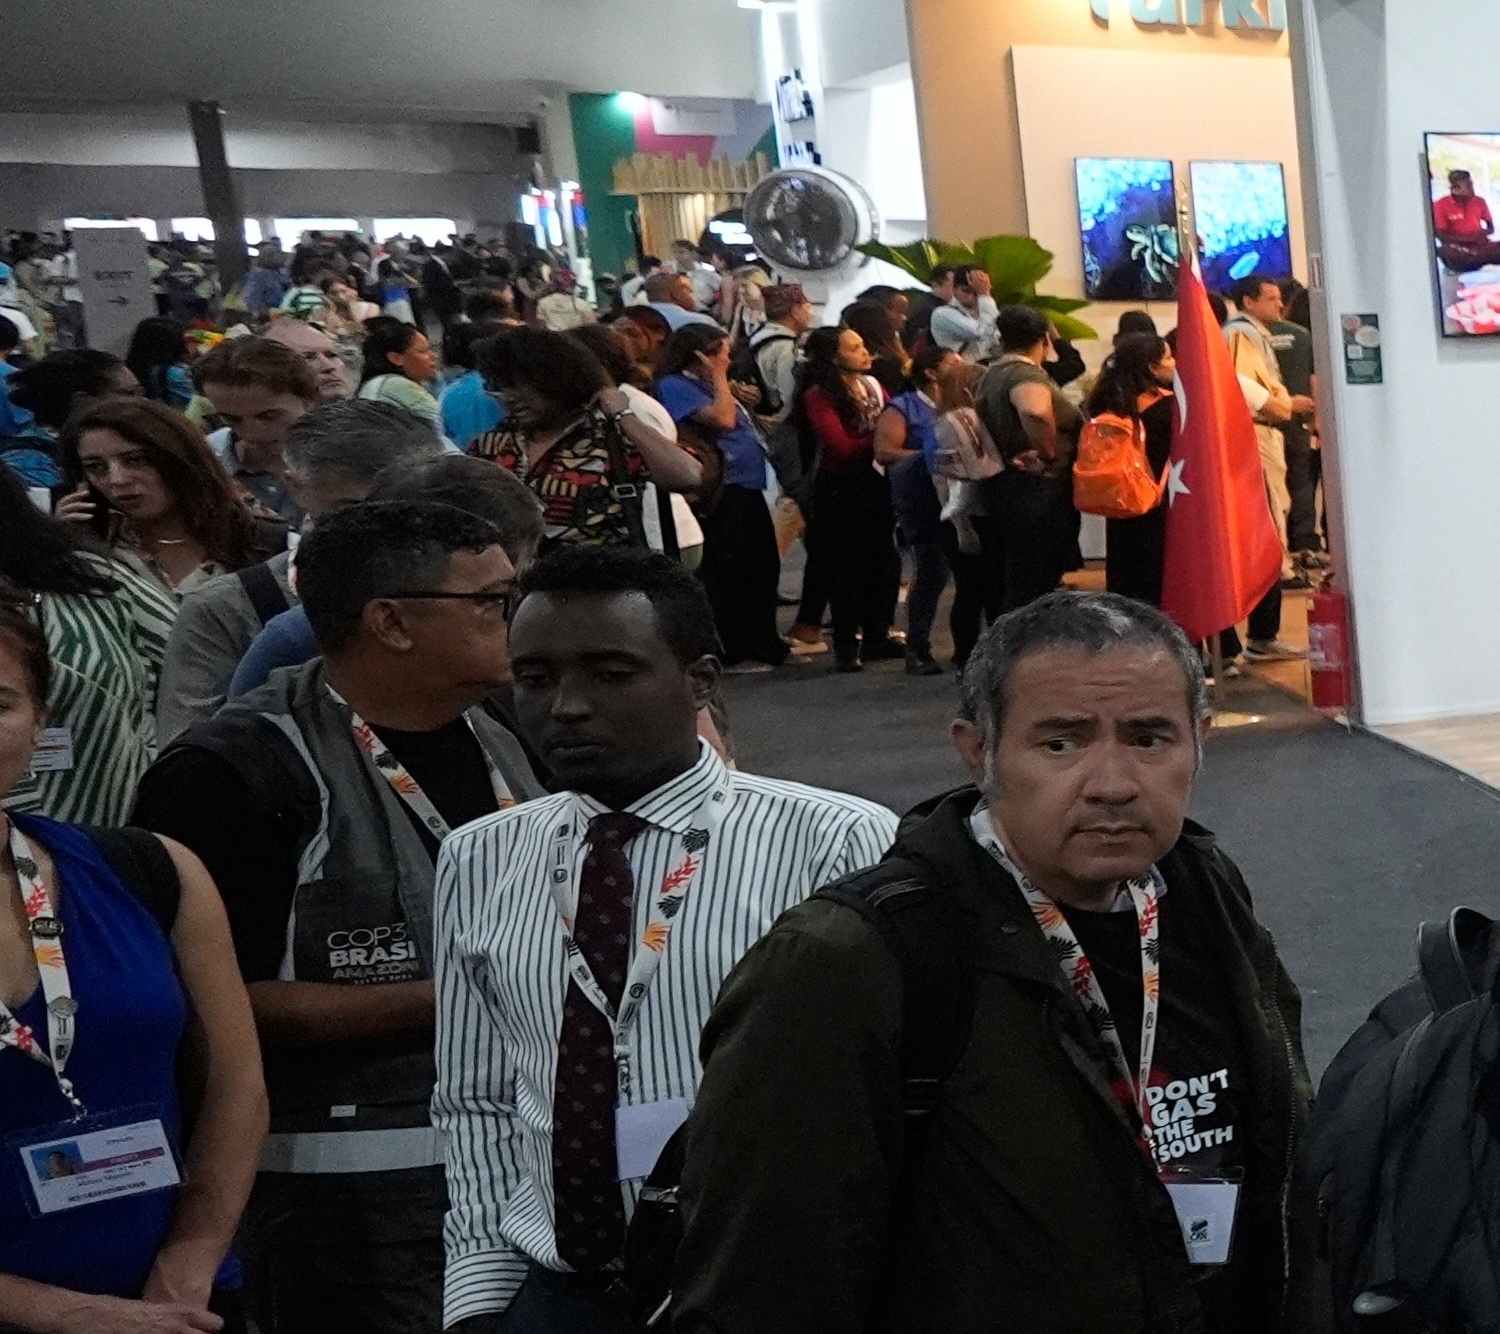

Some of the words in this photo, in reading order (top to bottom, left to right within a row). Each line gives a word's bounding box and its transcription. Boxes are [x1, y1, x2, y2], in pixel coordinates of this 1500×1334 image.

[1145, 1068, 1229, 1106] DON'T
[1151, 1092, 1217, 1127] GAS
[1153, 1118, 1195, 1146] THE
[1158, 1124, 1234, 1164] SOUTH
